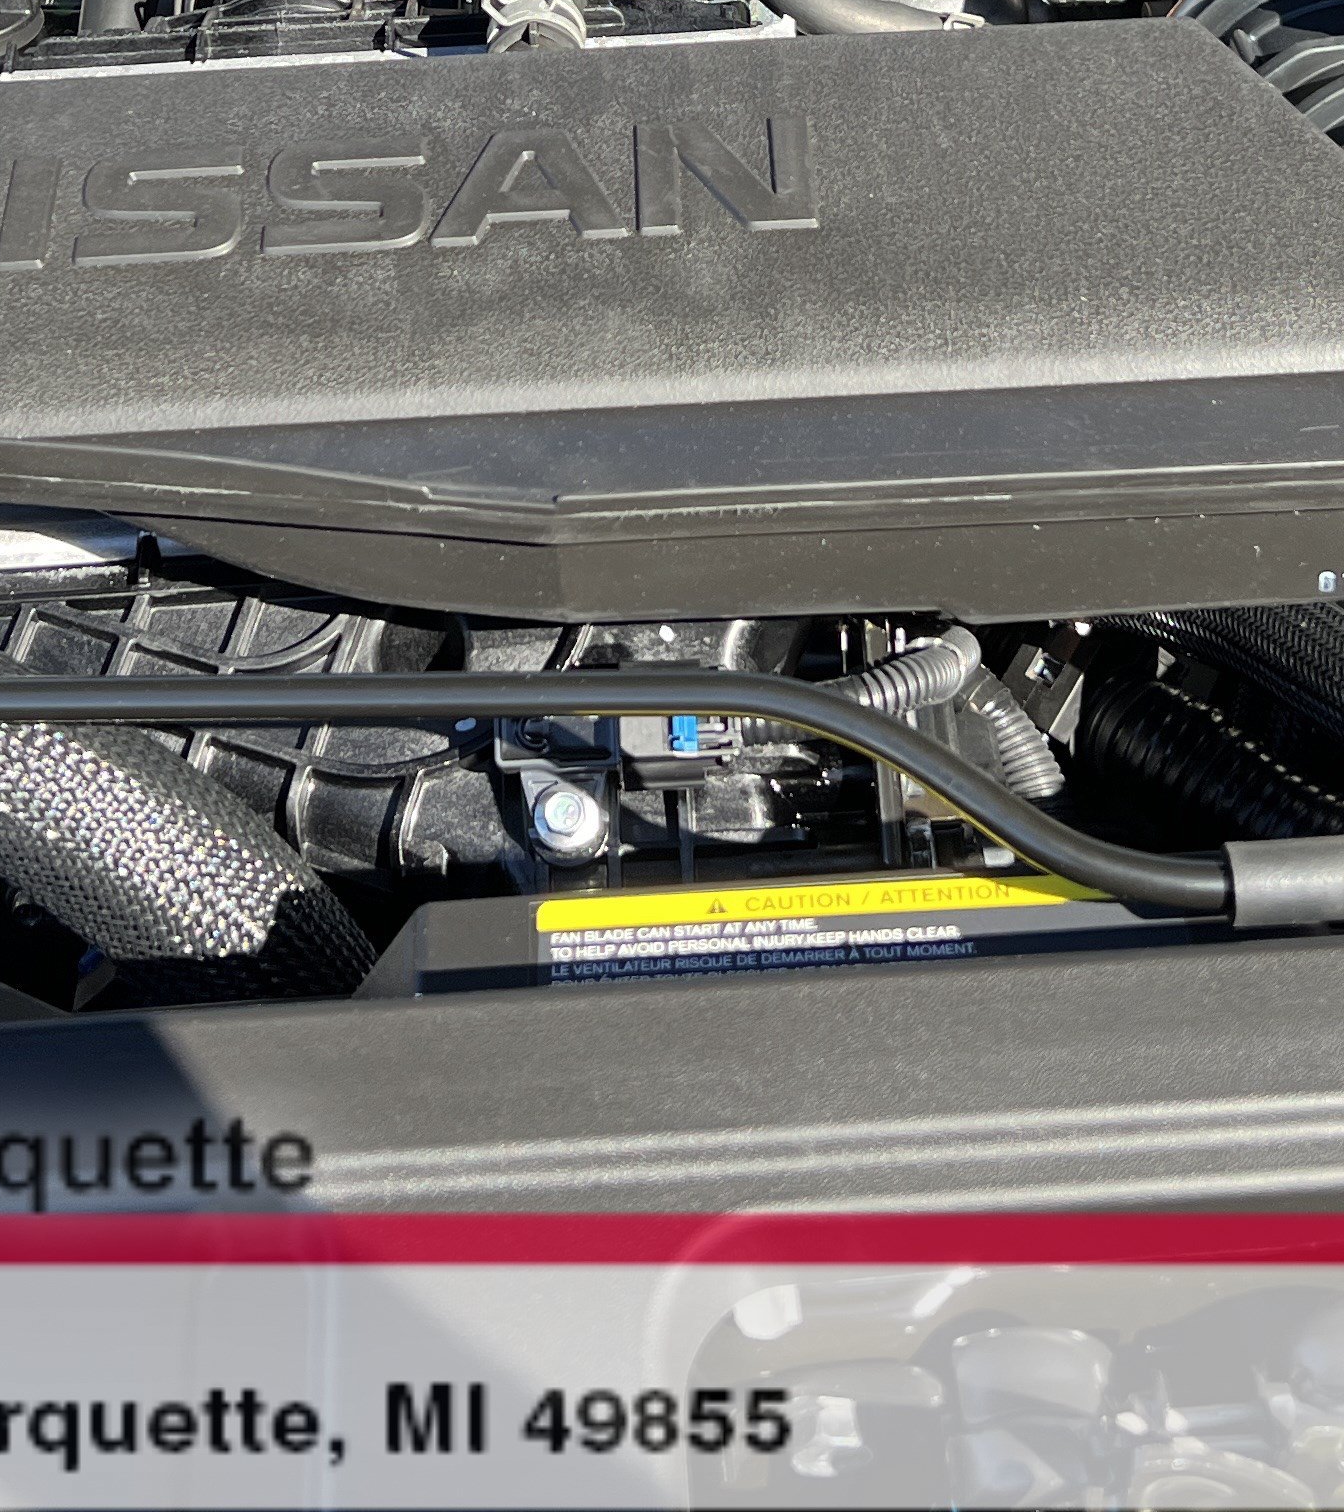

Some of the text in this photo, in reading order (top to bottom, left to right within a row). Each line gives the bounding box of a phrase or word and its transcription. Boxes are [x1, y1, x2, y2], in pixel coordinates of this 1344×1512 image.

[744, 891, 851, 913] CAUTION
[879, 884, 1011, 906] ATTENTION
[550, 917, 819, 945] FAN BLADE CAN START AT ANY TIME.
[551, 946, 573, 961] TO
[575, 943, 617, 960] HELP
[617, 941, 666, 957] AVOID
[668, 937, 751, 956] PERSONAL
[806, 930, 846, 946] KEEP
[848, 927, 904, 945] HANDS
[906, 925, 962, 942] CLEAR.
[550, 964, 570, 977] LE
[573, 956, 672, 975] VENTILATEUR
[674, 953, 733, 969] RISQUE
[736, 952, 757, 966] DE
[848, 943, 860, 961] À
[863, 944, 903, 959] TOUT
